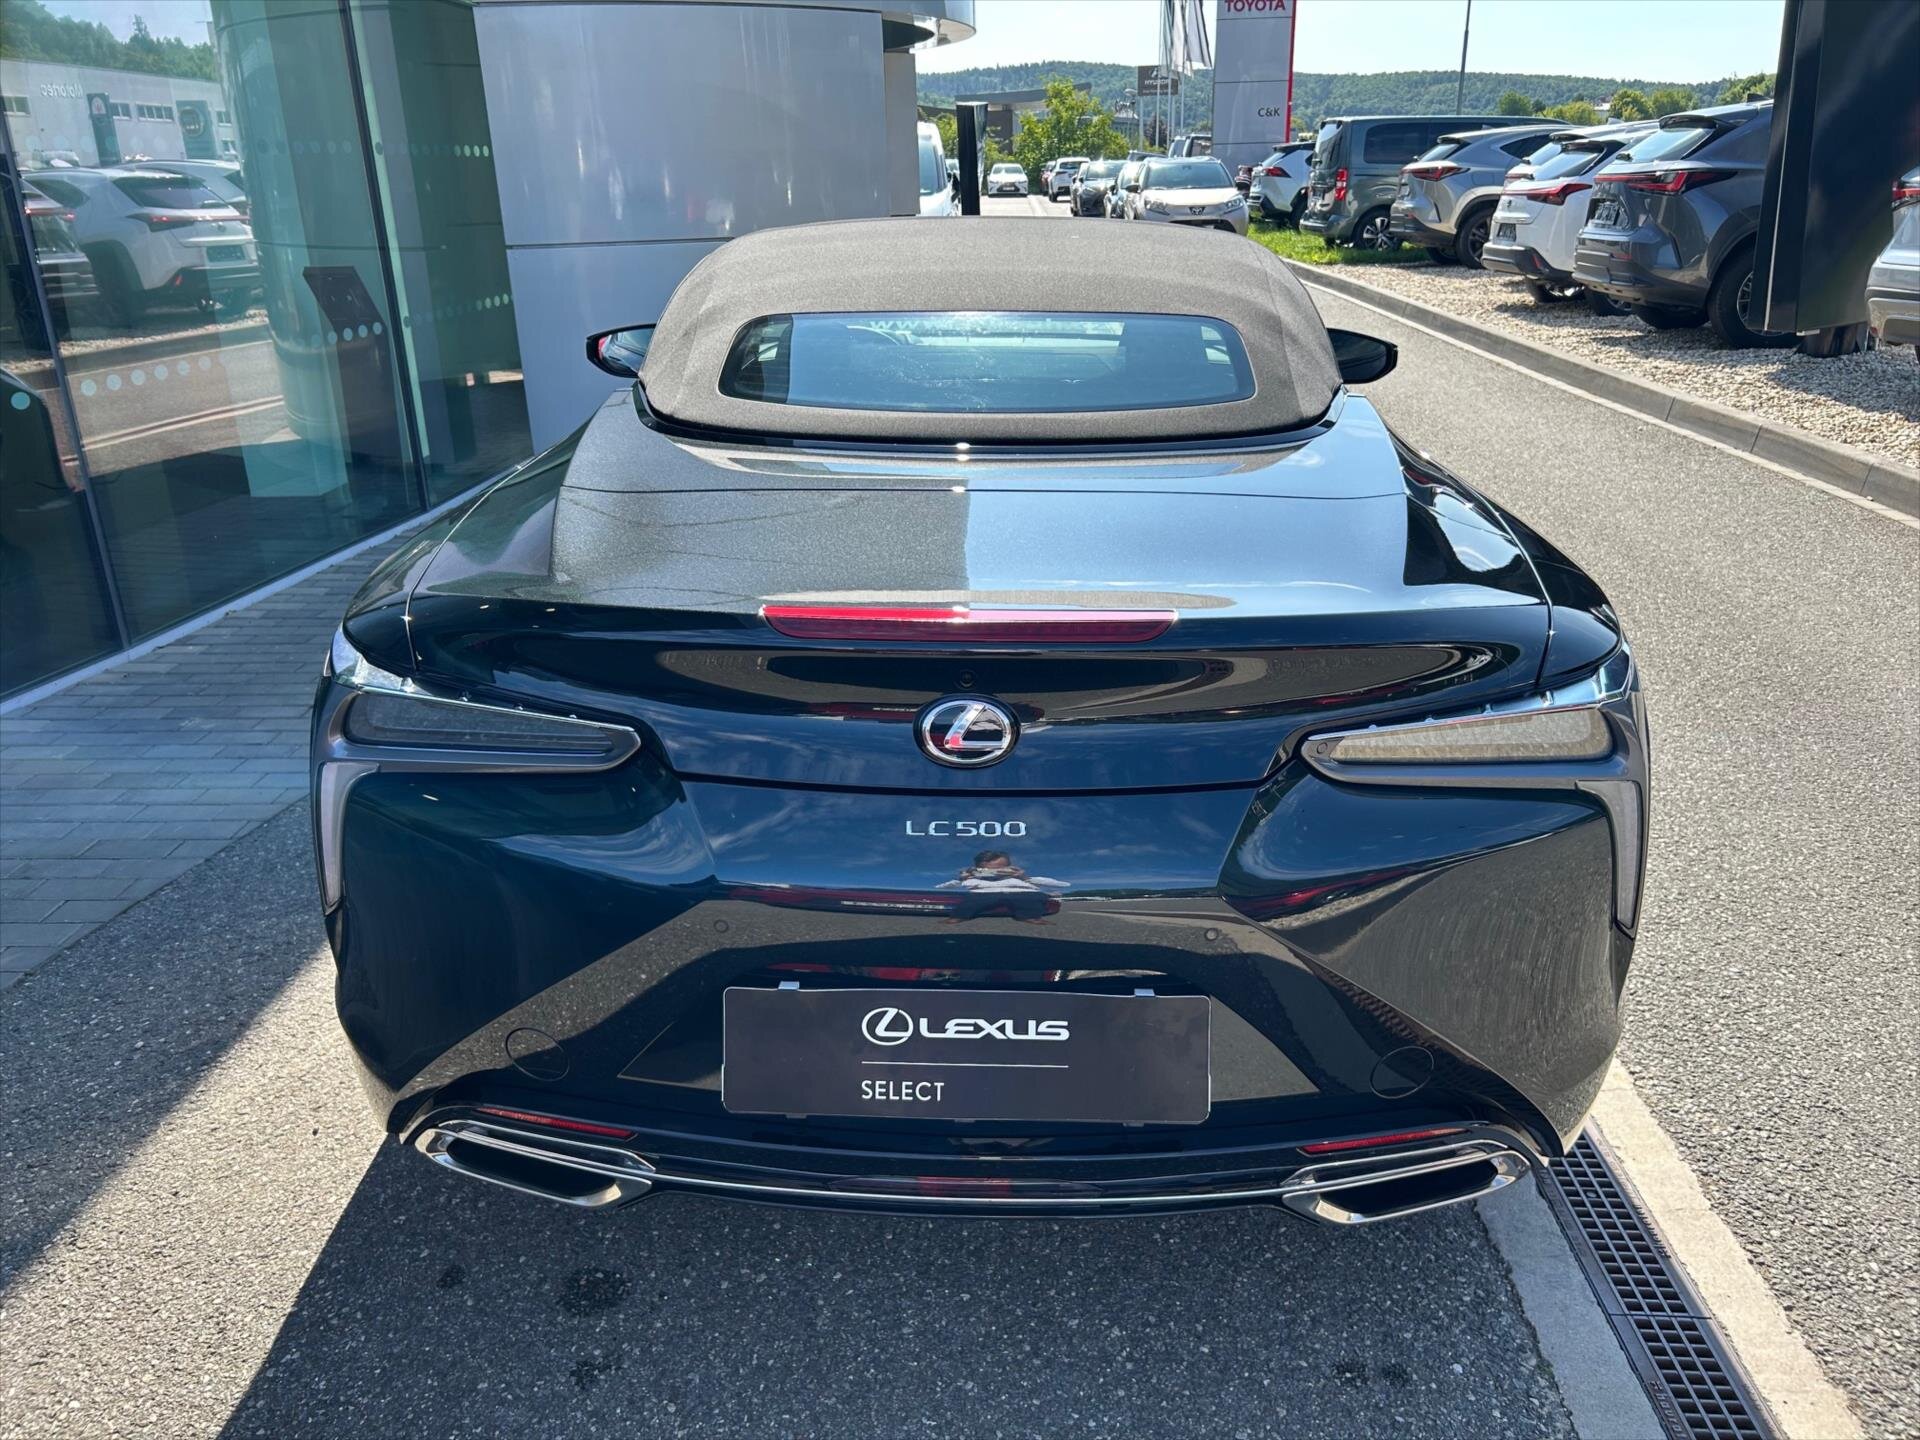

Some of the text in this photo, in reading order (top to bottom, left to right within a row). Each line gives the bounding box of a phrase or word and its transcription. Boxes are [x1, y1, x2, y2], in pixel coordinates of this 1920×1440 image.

[1225, 0, 1286, 12] TOYOTA
[1257, 107, 1280, 117] C&K
[905, 820, 1027, 837] LC 500
[919, 1017, 1070, 1041] LEXUS
[861, 1080, 945, 1101] SELECT
